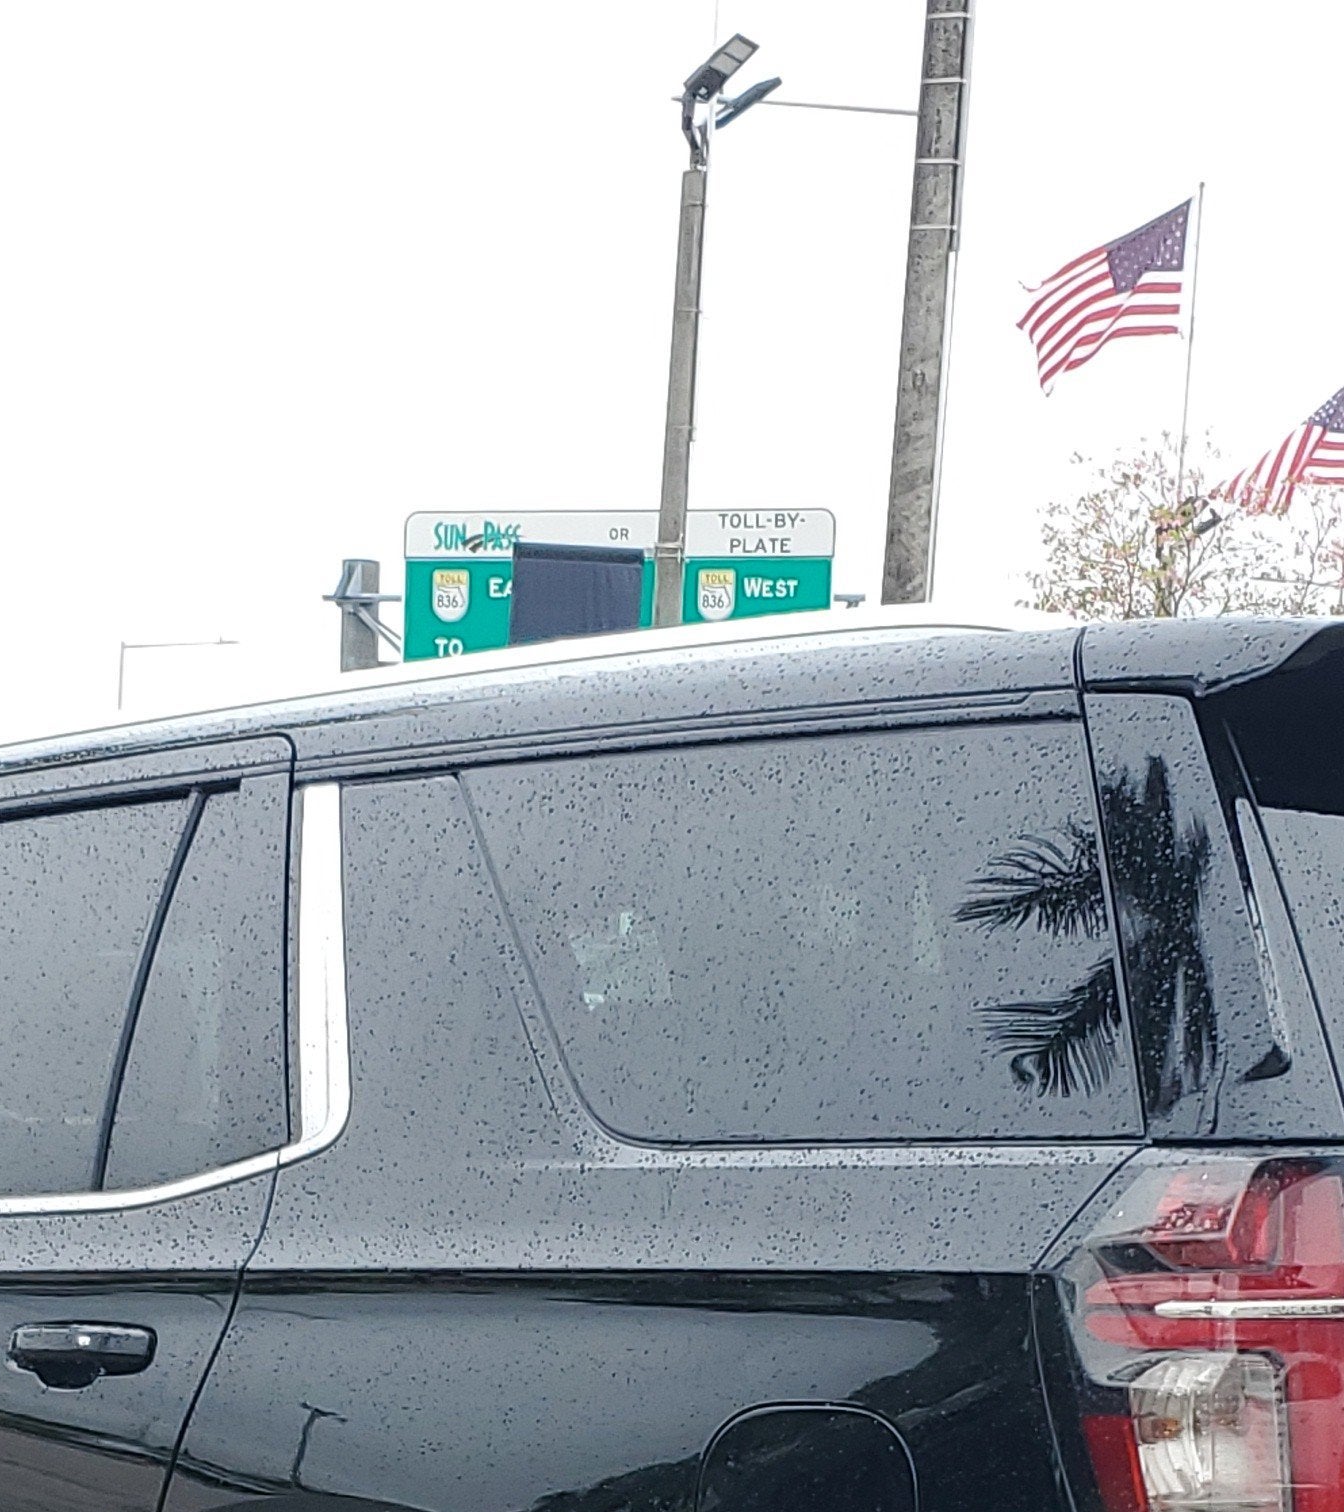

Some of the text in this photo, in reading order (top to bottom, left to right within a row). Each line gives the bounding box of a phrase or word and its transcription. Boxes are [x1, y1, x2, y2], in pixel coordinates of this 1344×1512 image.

[609, 527, 630, 541] OR
[729, 538, 791, 554] PLATE
[439, 573, 465, 585] TOLL
[705, 573, 730, 584] TOLL
[488, 577, 514, 599] EA
[743, 577, 799, 599] WEST
[437, 594, 459, 609] 836
[702, 594, 725, 609] 836
[434, 636, 464, 658] TO
